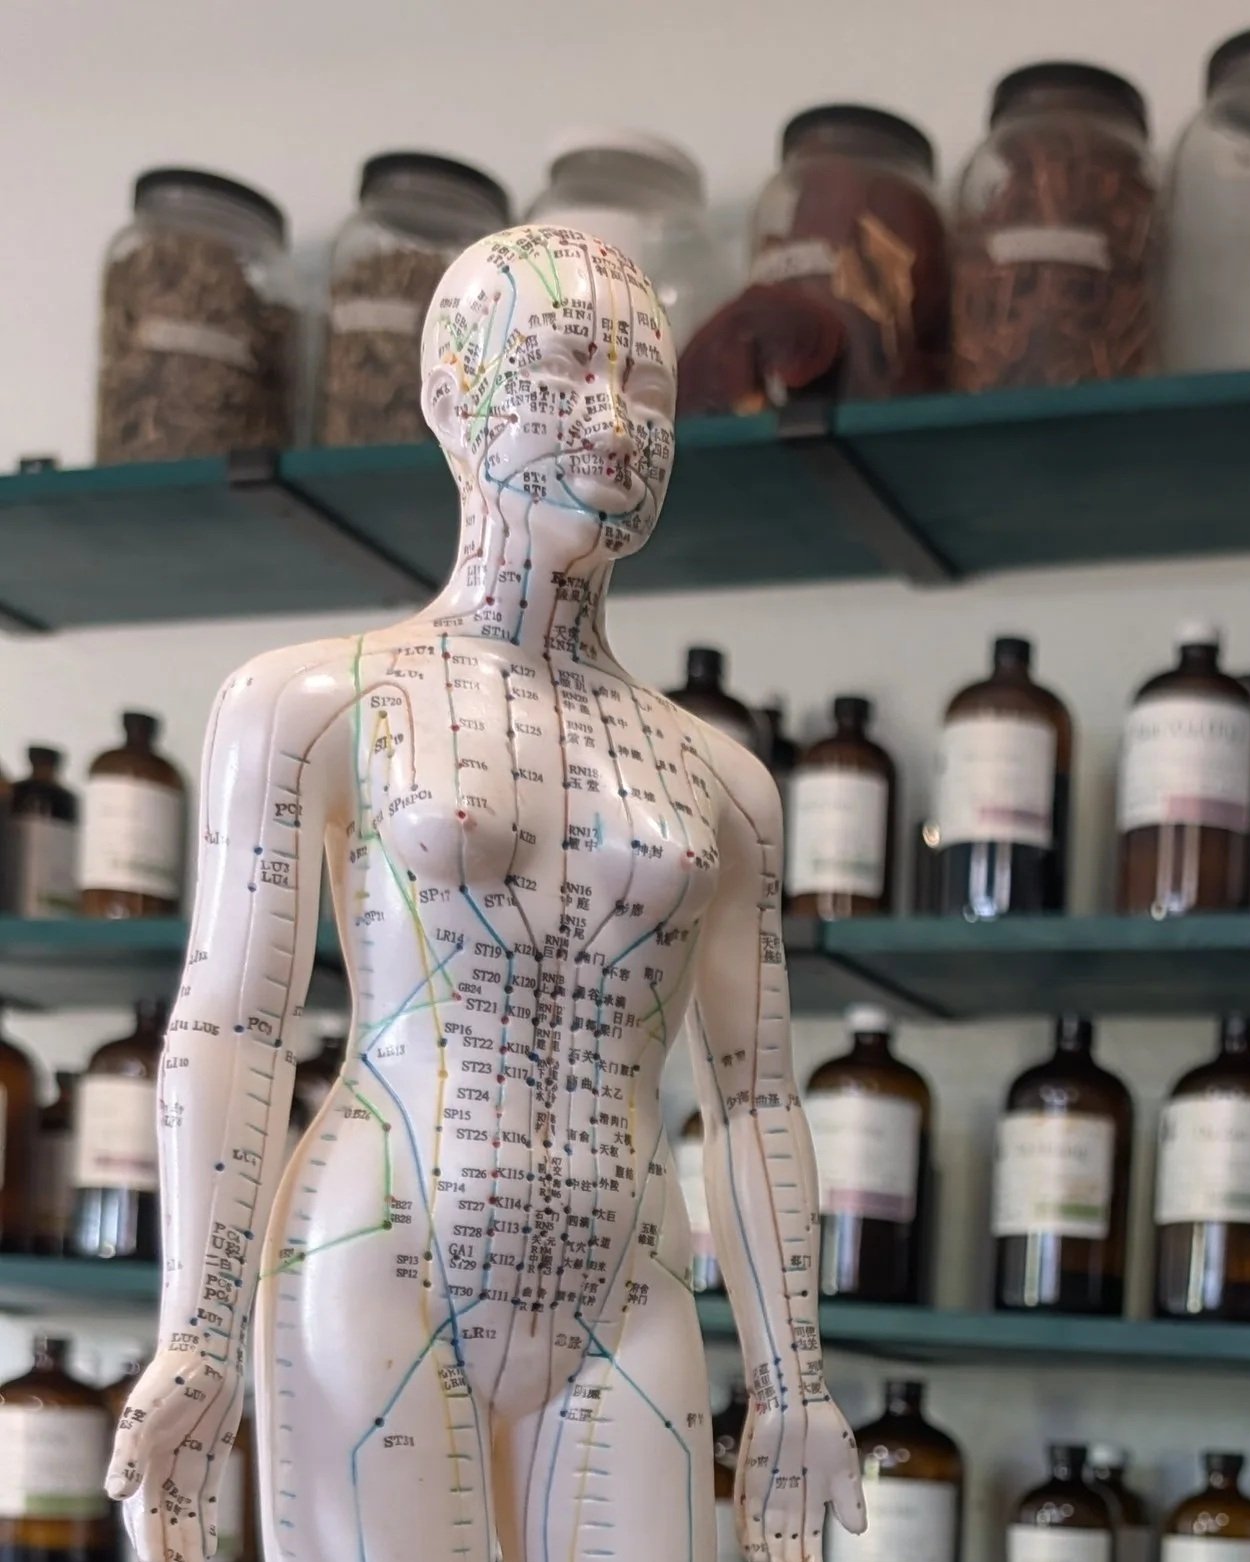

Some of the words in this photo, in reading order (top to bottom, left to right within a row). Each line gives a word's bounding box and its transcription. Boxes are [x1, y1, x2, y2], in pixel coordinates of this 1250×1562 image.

[523, 472, 547, 484] ST4
[474, 610, 502, 623] ST10
[481, 625, 510, 640] ST11
[452, 656, 478, 666] ST13
[459, 719, 484, 731] ST15
[569, 764, 598, 778] RN18
[420, 888, 450, 904] SP17
[436, 928, 465, 943] LR14
[475, 943, 502, 958] ST19
[472, 969, 500, 984] ST20
[512, 975, 536, 989] KI20
[458, 985, 482, 995] GB24
[466, 998, 497, 1015] ST21
[508, 1007, 531, 1019] KI19
[445, 1023, 473, 1036] SP16
[463, 1037, 494, 1050] ST22
[506, 1042, 529, 1055] KI18
[462, 1061, 492, 1074] ST23
[505, 1067, 528, 1080] KI17
[457, 1087, 490, 1102] ST24
[601, 1086, 624, 1100] 太乙
[444, 1109, 471, 1121] SP15
[456, 1129, 488, 1142] ST25
[503, 1132, 527, 1144] KI16
[461, 1168, 487, 1179] ST26
[498, 1168, 525, 1180] KI15
[438, 1181, 466, 1194] SP14
[458, 1200, 485, 1211] ST27
[496, 1198, 521, 1210] KI14
[453, 1225, 482, 1239] ST28
[493, 1220, 519, 1234] KI13
[396, 1254, 419, 1265] SP13
[489, 1253, 515, 1266] KI12
[396, 1268, 418, 1279] SP12
[463, 1325, 496, 1340] LR12
[384, 1435, 415, 1448] ST31
